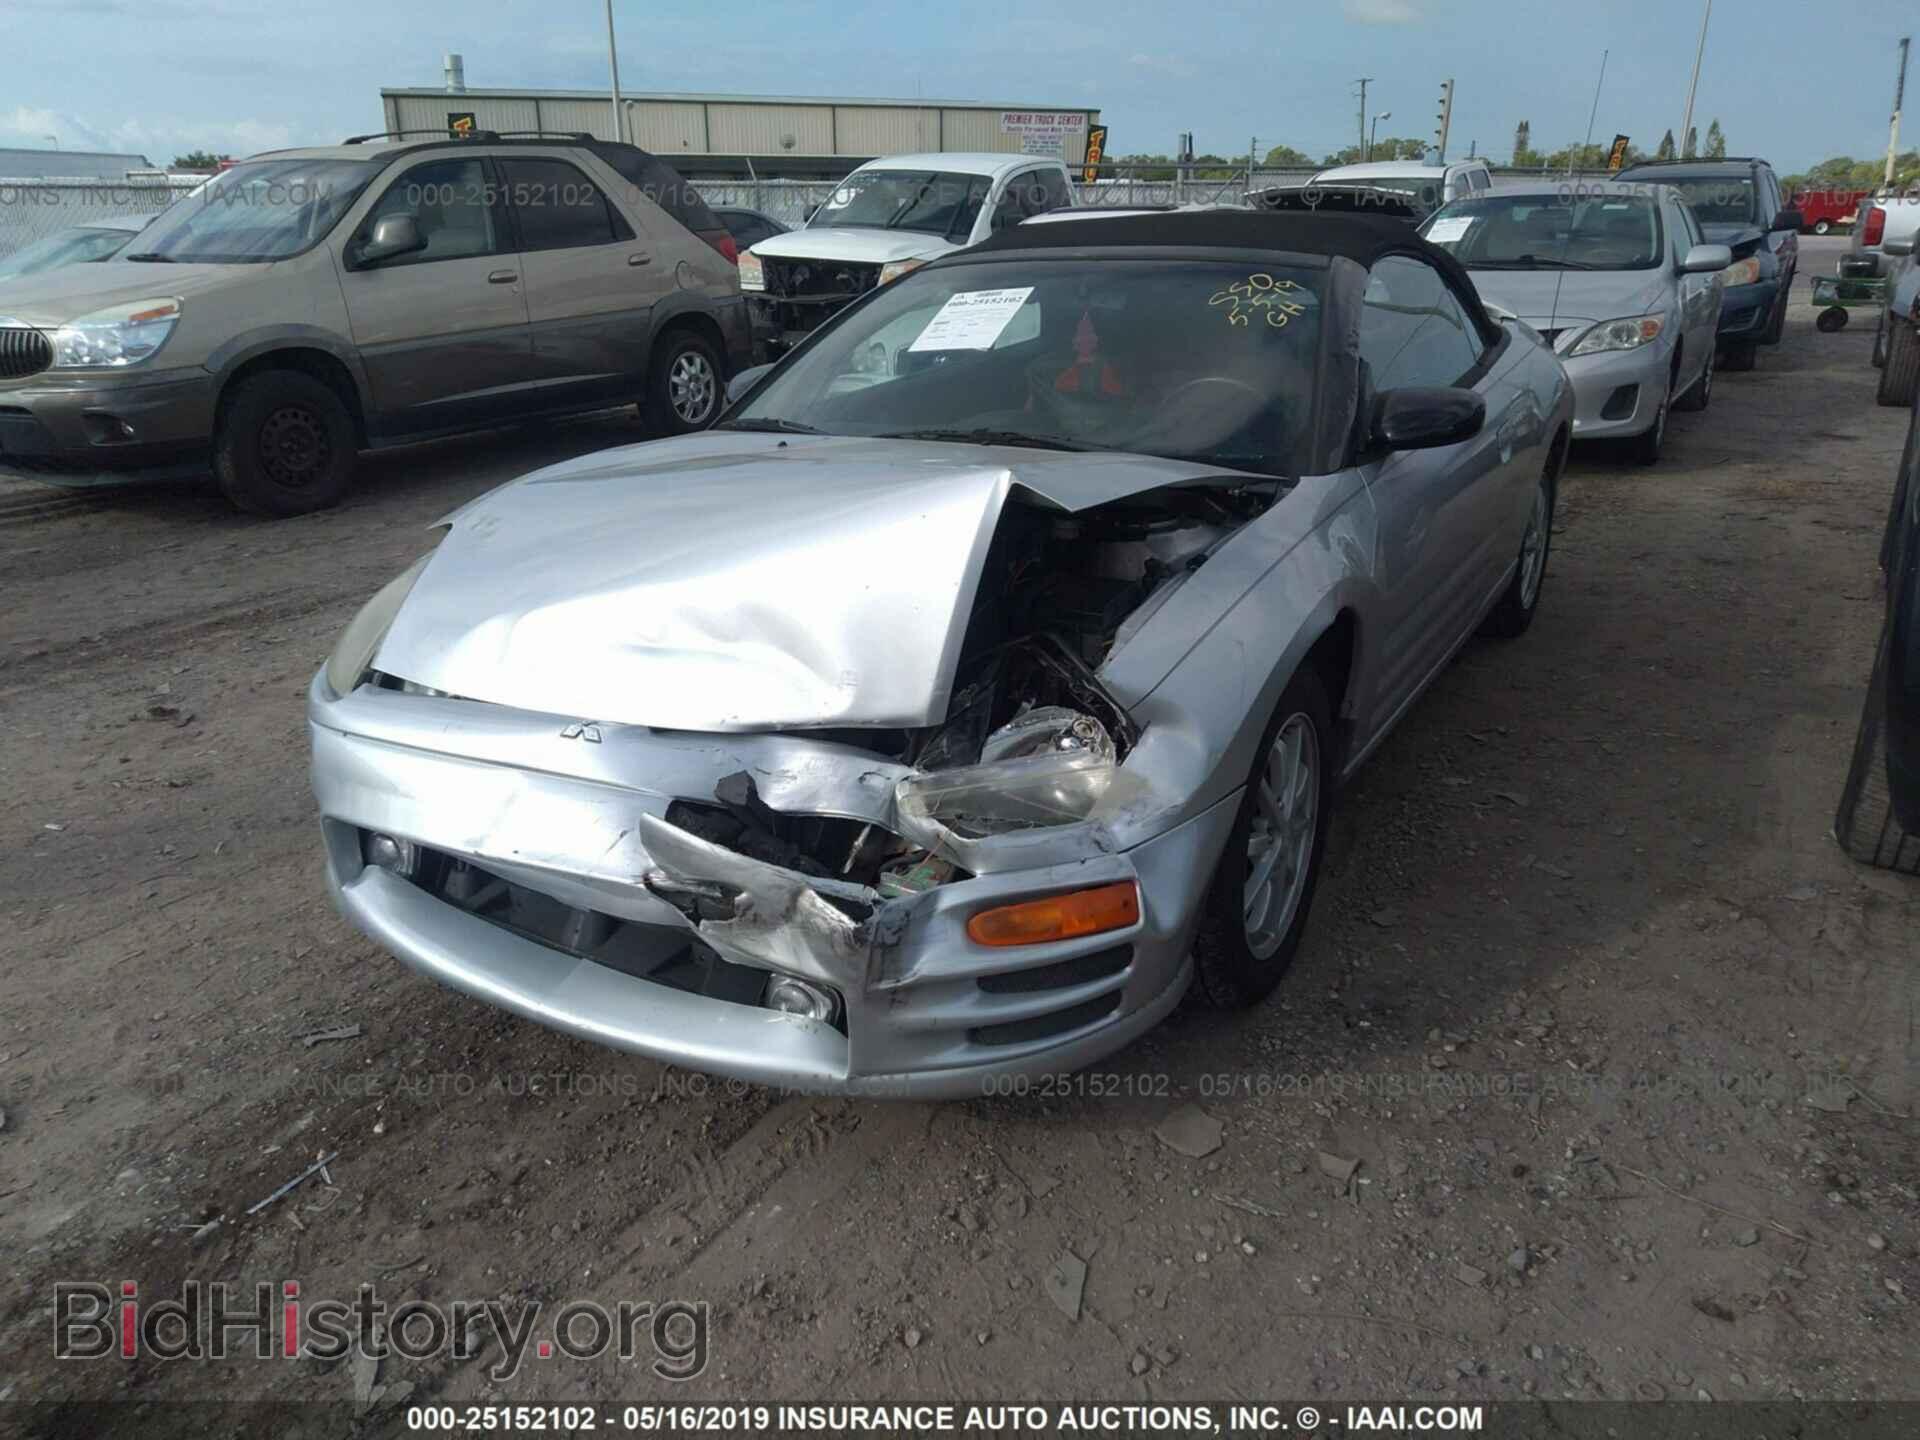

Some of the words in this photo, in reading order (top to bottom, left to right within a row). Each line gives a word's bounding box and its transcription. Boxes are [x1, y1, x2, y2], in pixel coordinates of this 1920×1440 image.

[1002, 114, 1033, 125] PREMIER
[1034, 114, 1055, 125] TRUCK
[1057, 115, 1084, 126] CENTER
